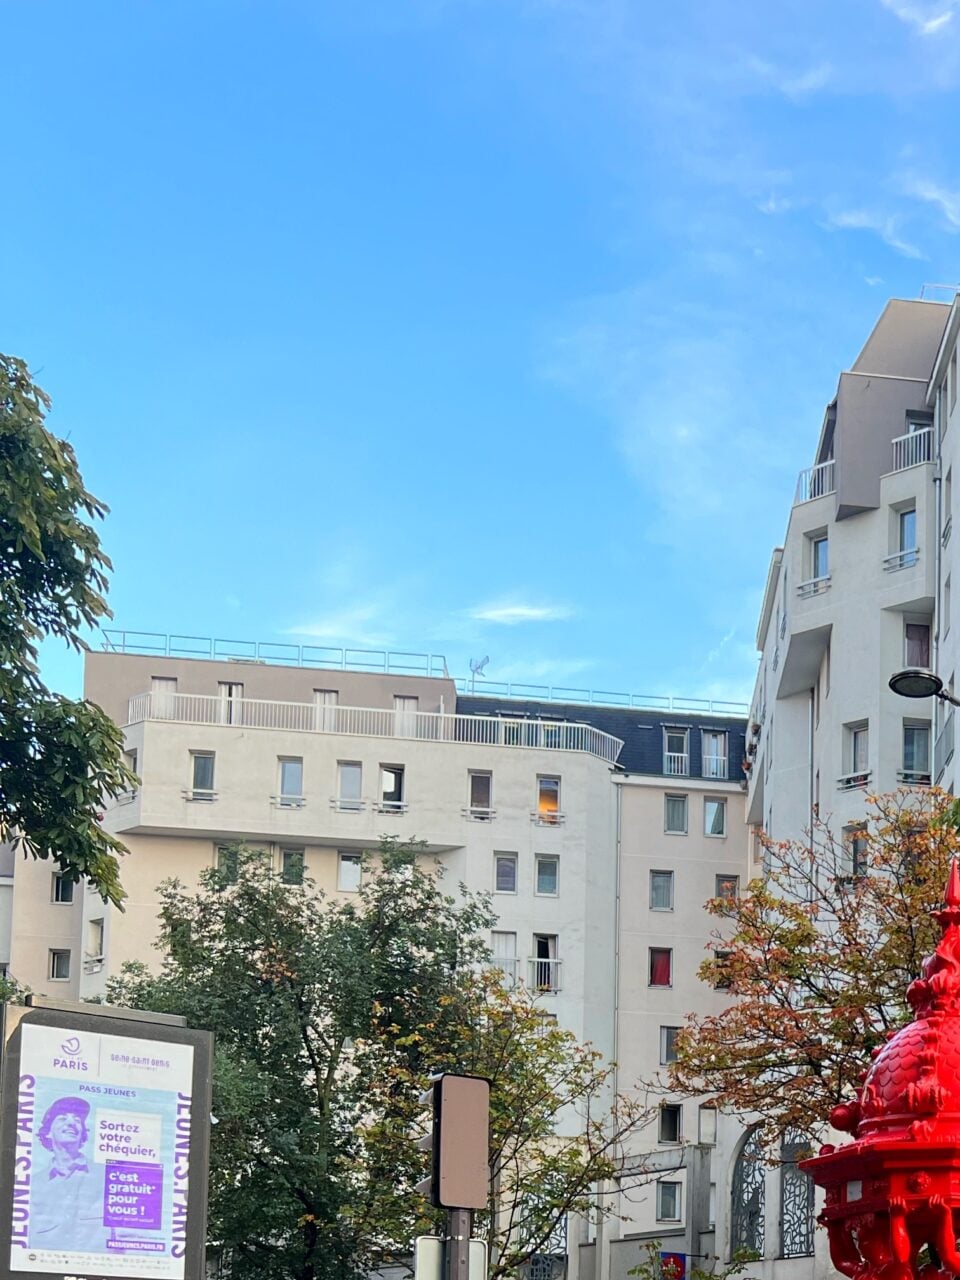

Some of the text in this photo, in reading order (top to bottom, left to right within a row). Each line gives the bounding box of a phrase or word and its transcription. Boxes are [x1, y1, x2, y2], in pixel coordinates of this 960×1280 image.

[53, 1058, 89, 1071] PARIS
[79, 1085, 137, 1098] PASS JEUNES
[100, 1120, 140, 1133] Sortez
[99, 1133, 132, 1143] votre
[99, 1143, 156, 1158] chéquier,
[109, 1172, 139, 1182] c'est
[108, 1195, 138, 1205] pour
[108, 1206, 137, 1215] vous
